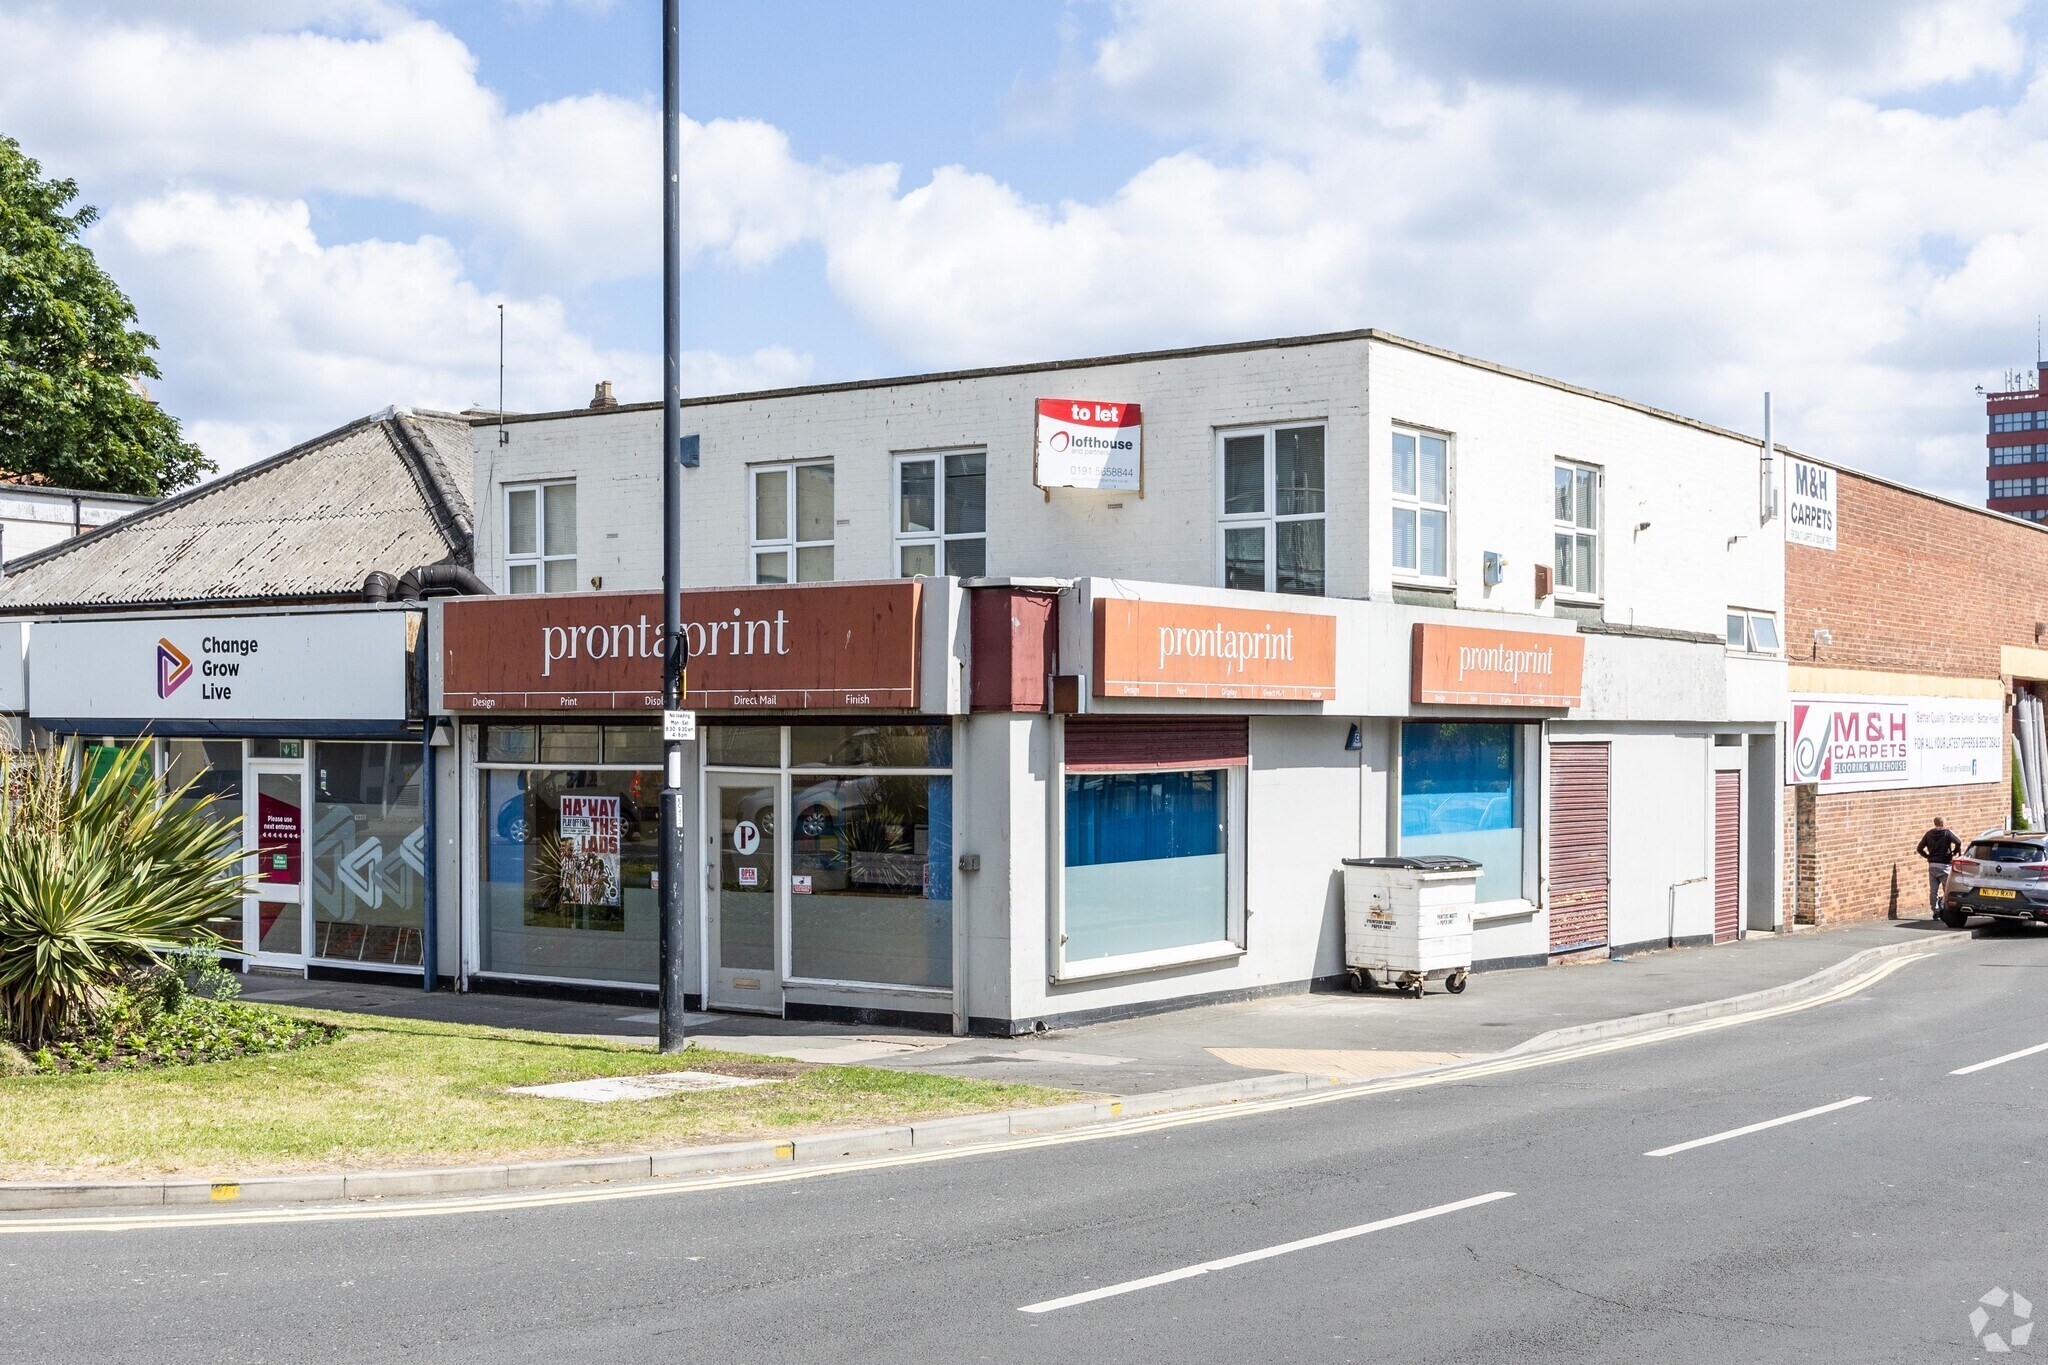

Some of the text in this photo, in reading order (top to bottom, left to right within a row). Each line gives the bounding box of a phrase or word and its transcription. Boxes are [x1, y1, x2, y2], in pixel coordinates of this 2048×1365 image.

[1071, 404, 1118, 422] to let
[1071, 435, 1133, 450] lofthouse
[1070, 465, 1092, 476] 0191
[1795, 463, 1827, 501] M&H
[1791, 502, 1832, 531] CARPETS
[202, 636, 258, 656] Change
[1158, 622, 1294, 673] prontaprint
[202, 660, 239, 677] Grow
[1458, 643, 1554, 684] prontaprint
[202, 683, 232, 700] Live
[845, 694, 870, 705] Finish
[472, 697, 495, 710] Design
[560, 696, 578, 707] Print
[645, 695, 665, 706] Displ
[734, 695, 777, 706] Direct Mail
[1834, 744, 1907, 760] CARPETS
[1835, 761, 1906, 773] FLOORING WAREHOUSE
[563, 799, 617, 817] HA'WAY
[267, 815, 283, 823] Please
[563, 818, 572, 826] PLAY
[591, 818, 618, 835] THE
[581, 835, 618, 854] LADS
[739, 826, 755, 849] P
[741, 869, 755, 877] OPEN
